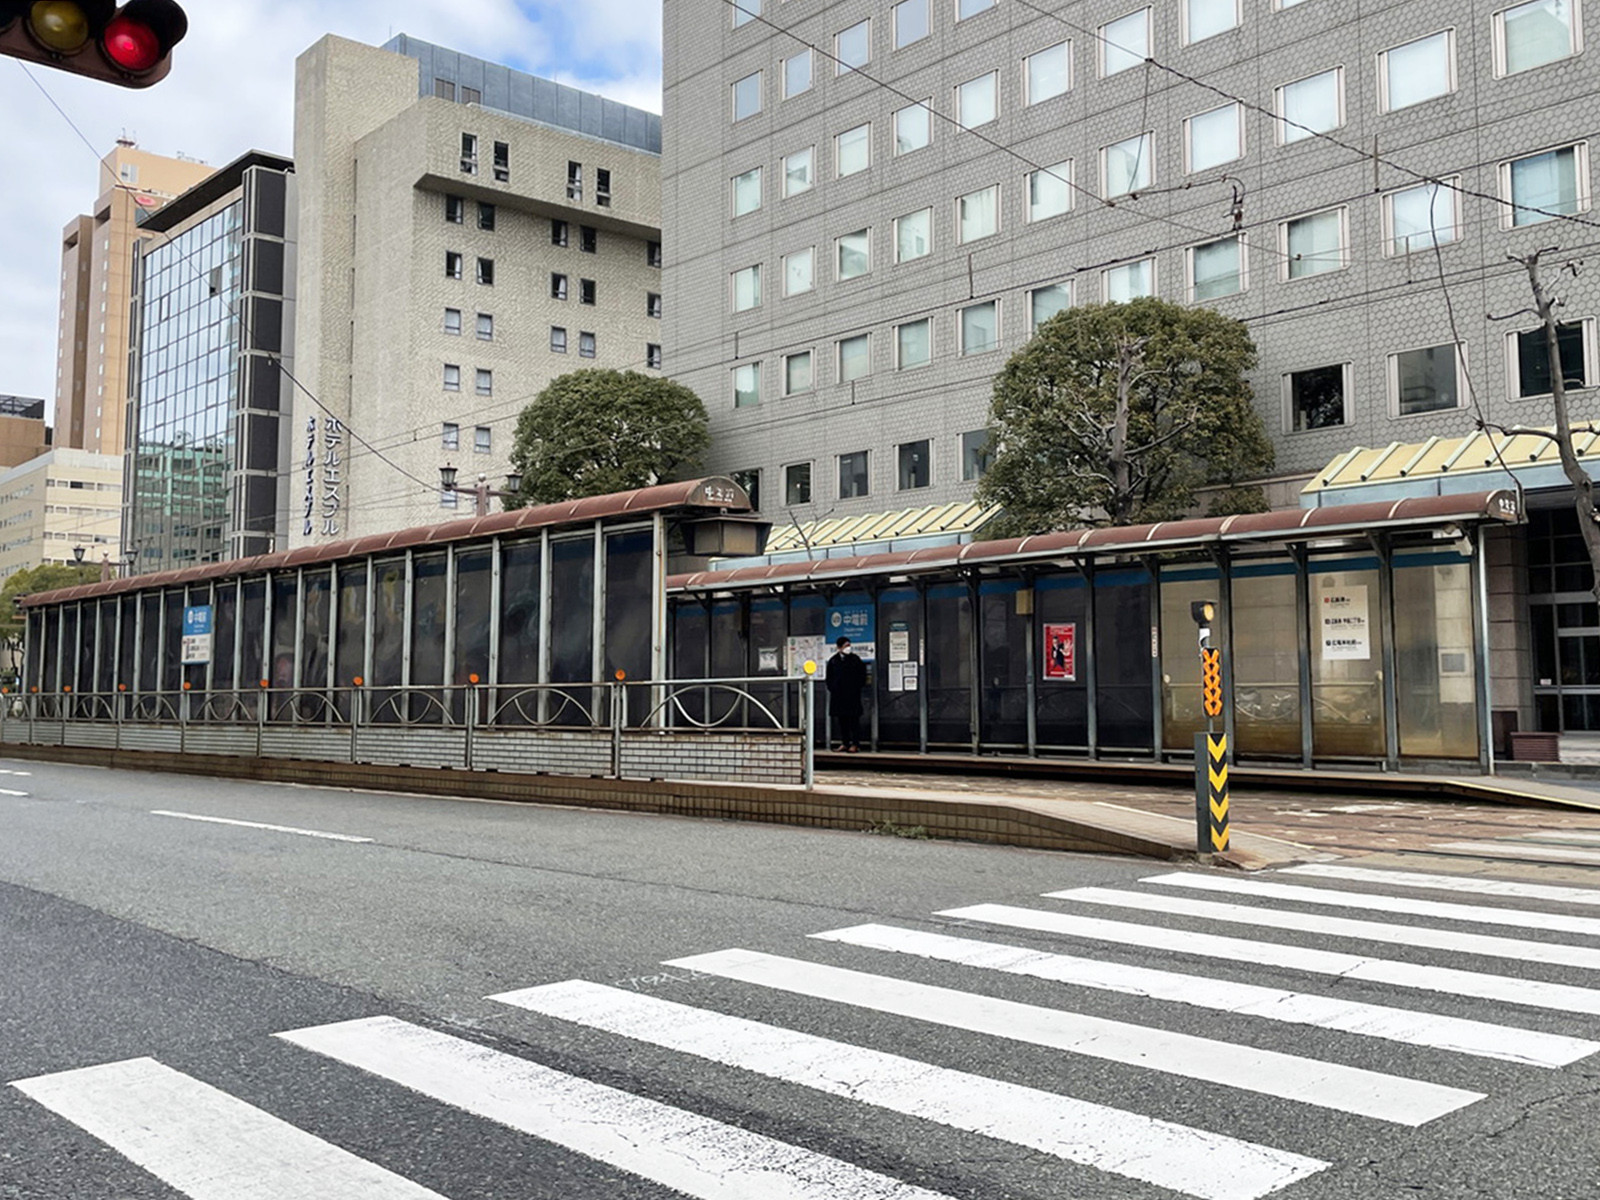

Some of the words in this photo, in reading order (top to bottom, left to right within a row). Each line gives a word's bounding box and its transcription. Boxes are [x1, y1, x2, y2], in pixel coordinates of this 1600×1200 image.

[321, 418, 342, 535] ホテルエスプル
